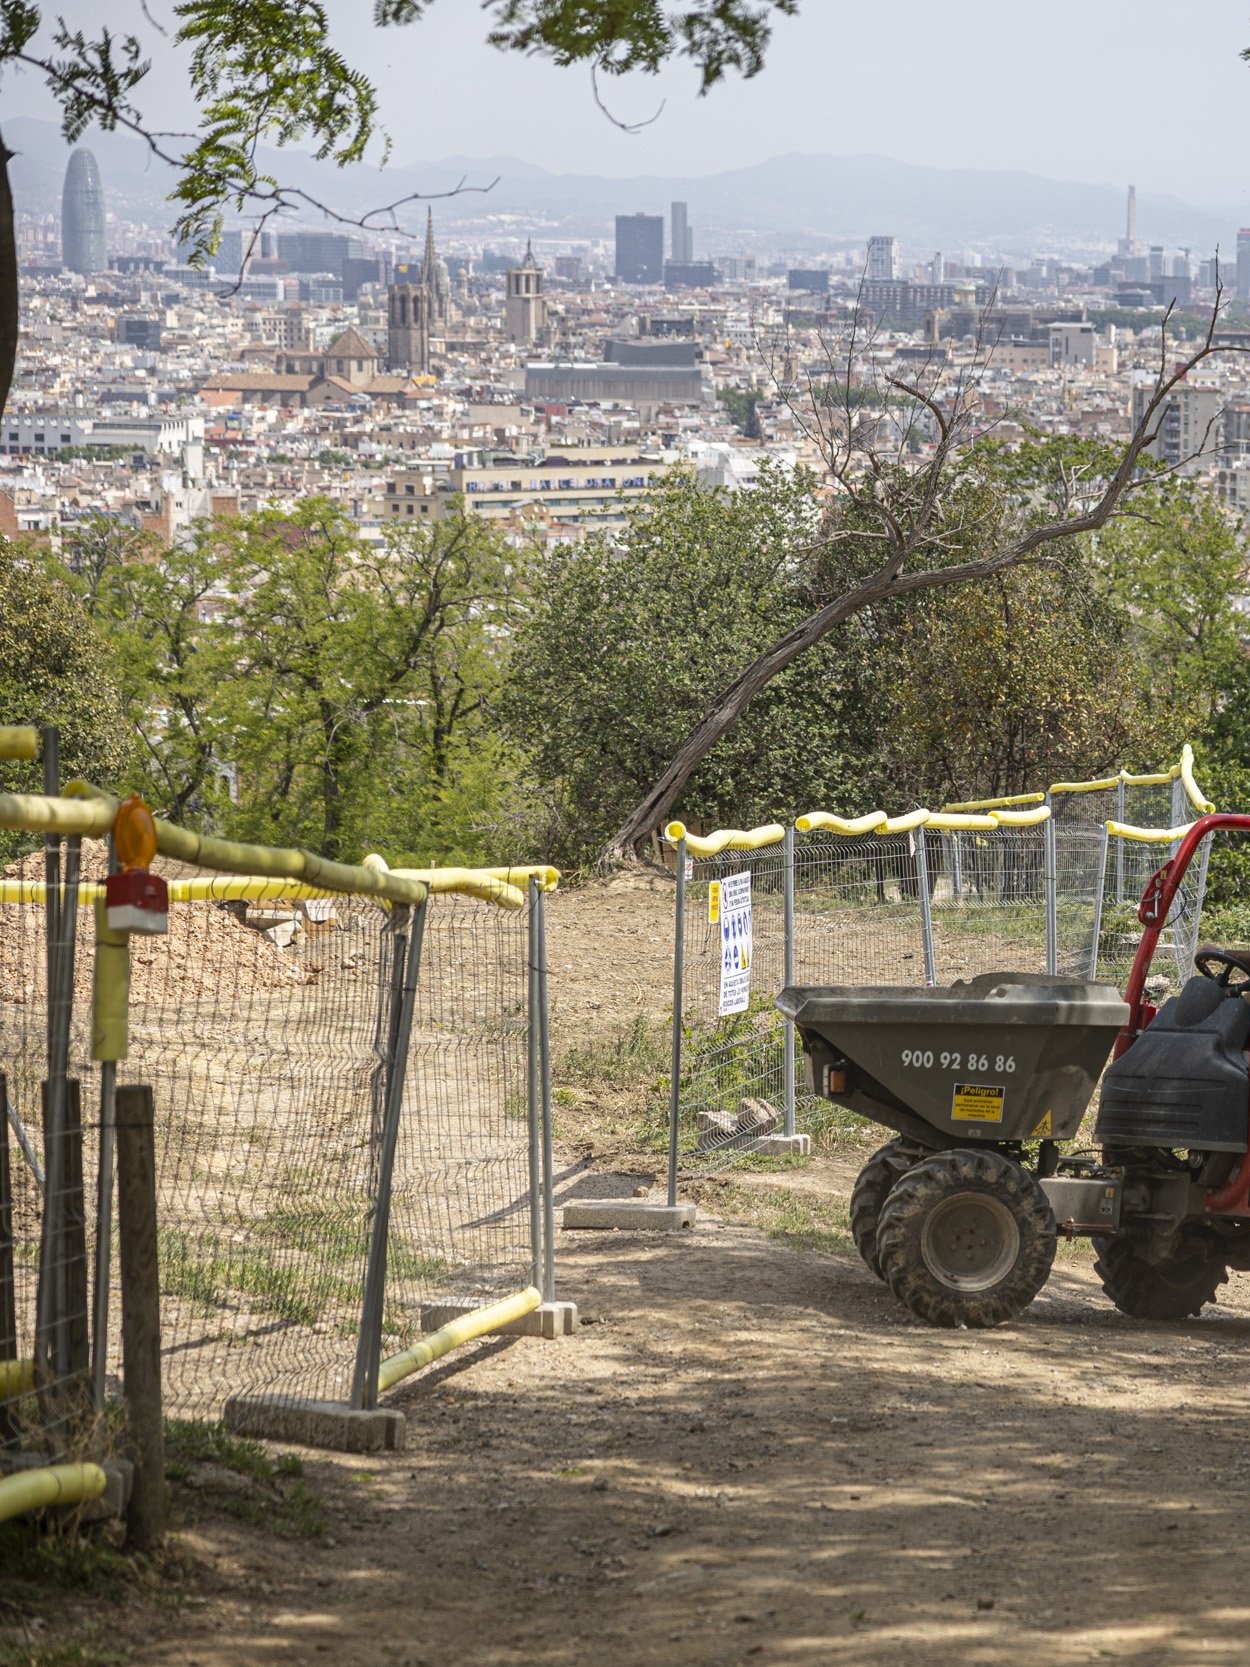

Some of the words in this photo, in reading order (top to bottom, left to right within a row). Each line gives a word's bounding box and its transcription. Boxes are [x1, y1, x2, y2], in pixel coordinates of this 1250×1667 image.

[901, 1049, 934, 1068] 900
[940, 1051, 961, 1069] 92
[967, 1053, 989, 1071] 86
[994, 1055, 1016, 1073] 86
[961, 1086, 999, 1097] ¡Peligro!
